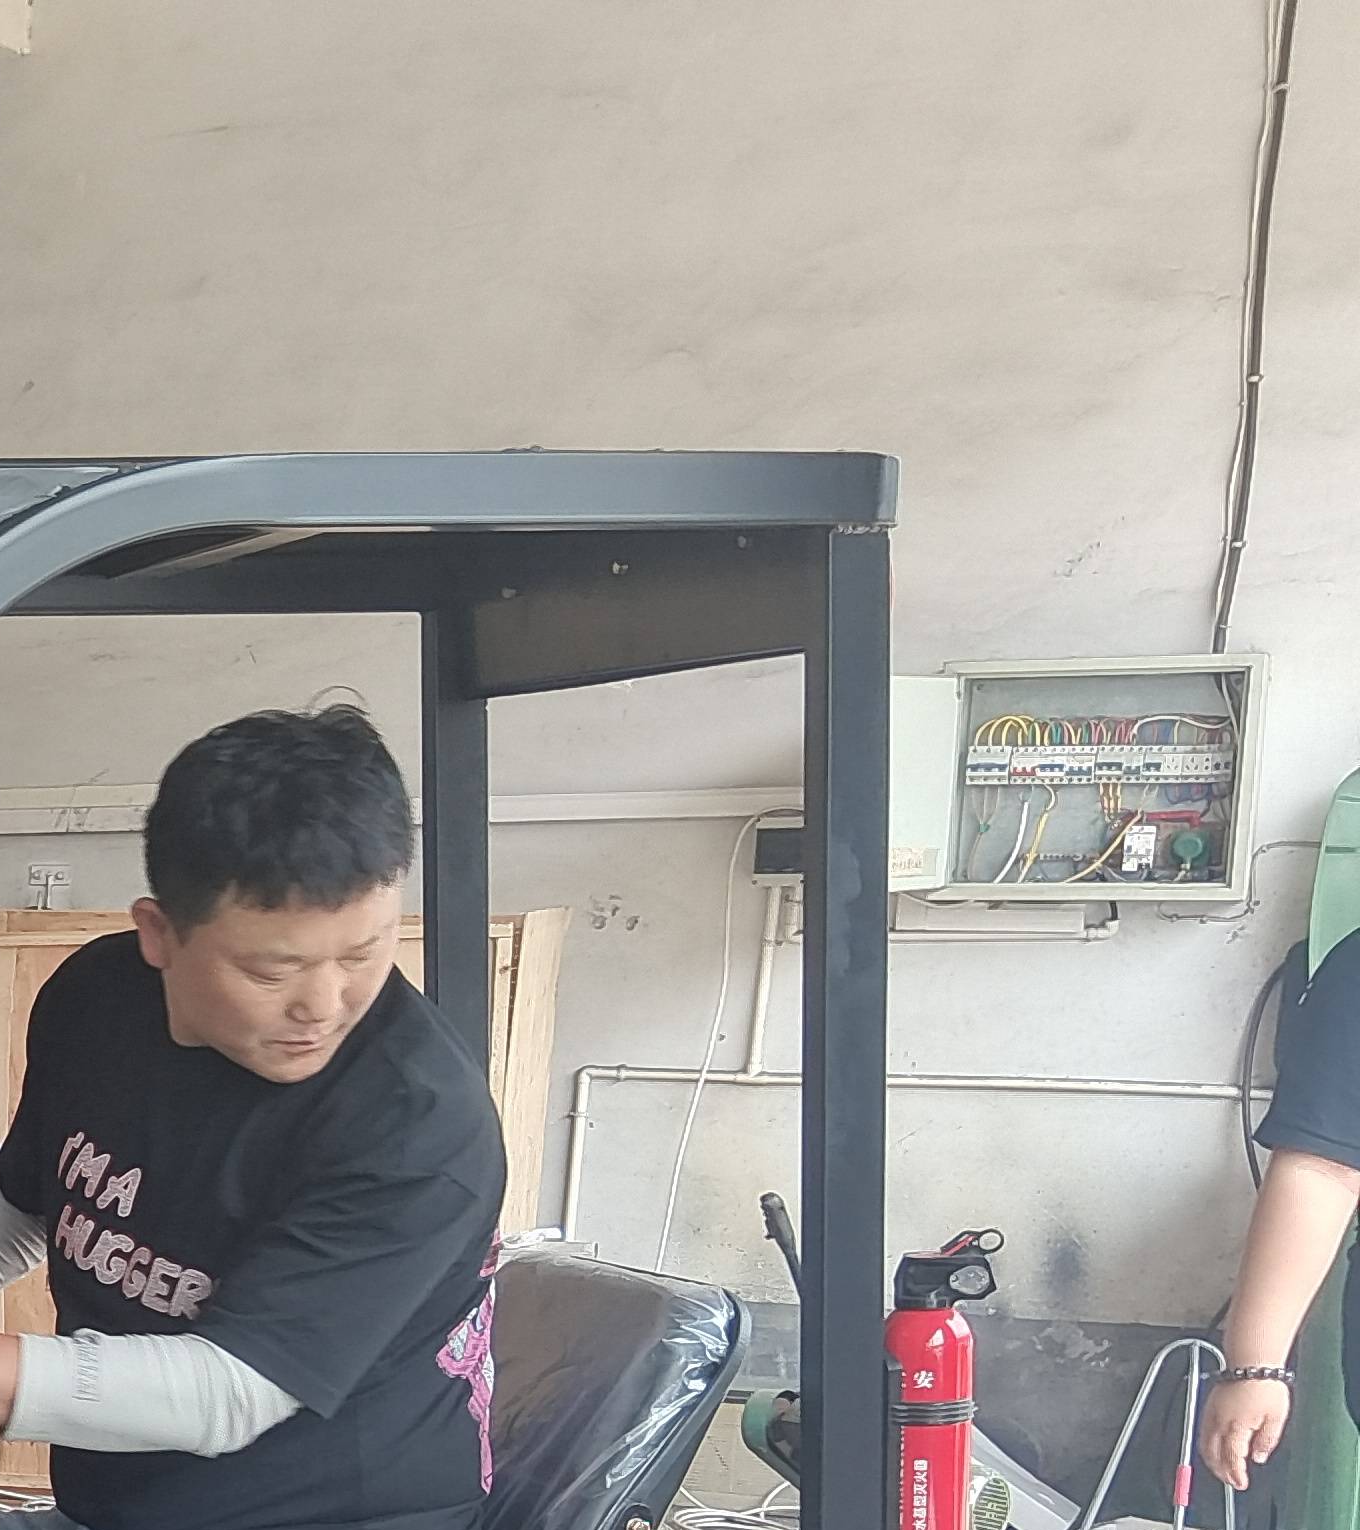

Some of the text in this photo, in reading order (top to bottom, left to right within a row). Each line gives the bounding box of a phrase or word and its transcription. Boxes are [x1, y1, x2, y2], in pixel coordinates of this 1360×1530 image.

[57, 1131, 143, 1218] I'M A
[54, 1203, 215, 1321] HUGGER
[901, 1369, 935, 1389] 安
